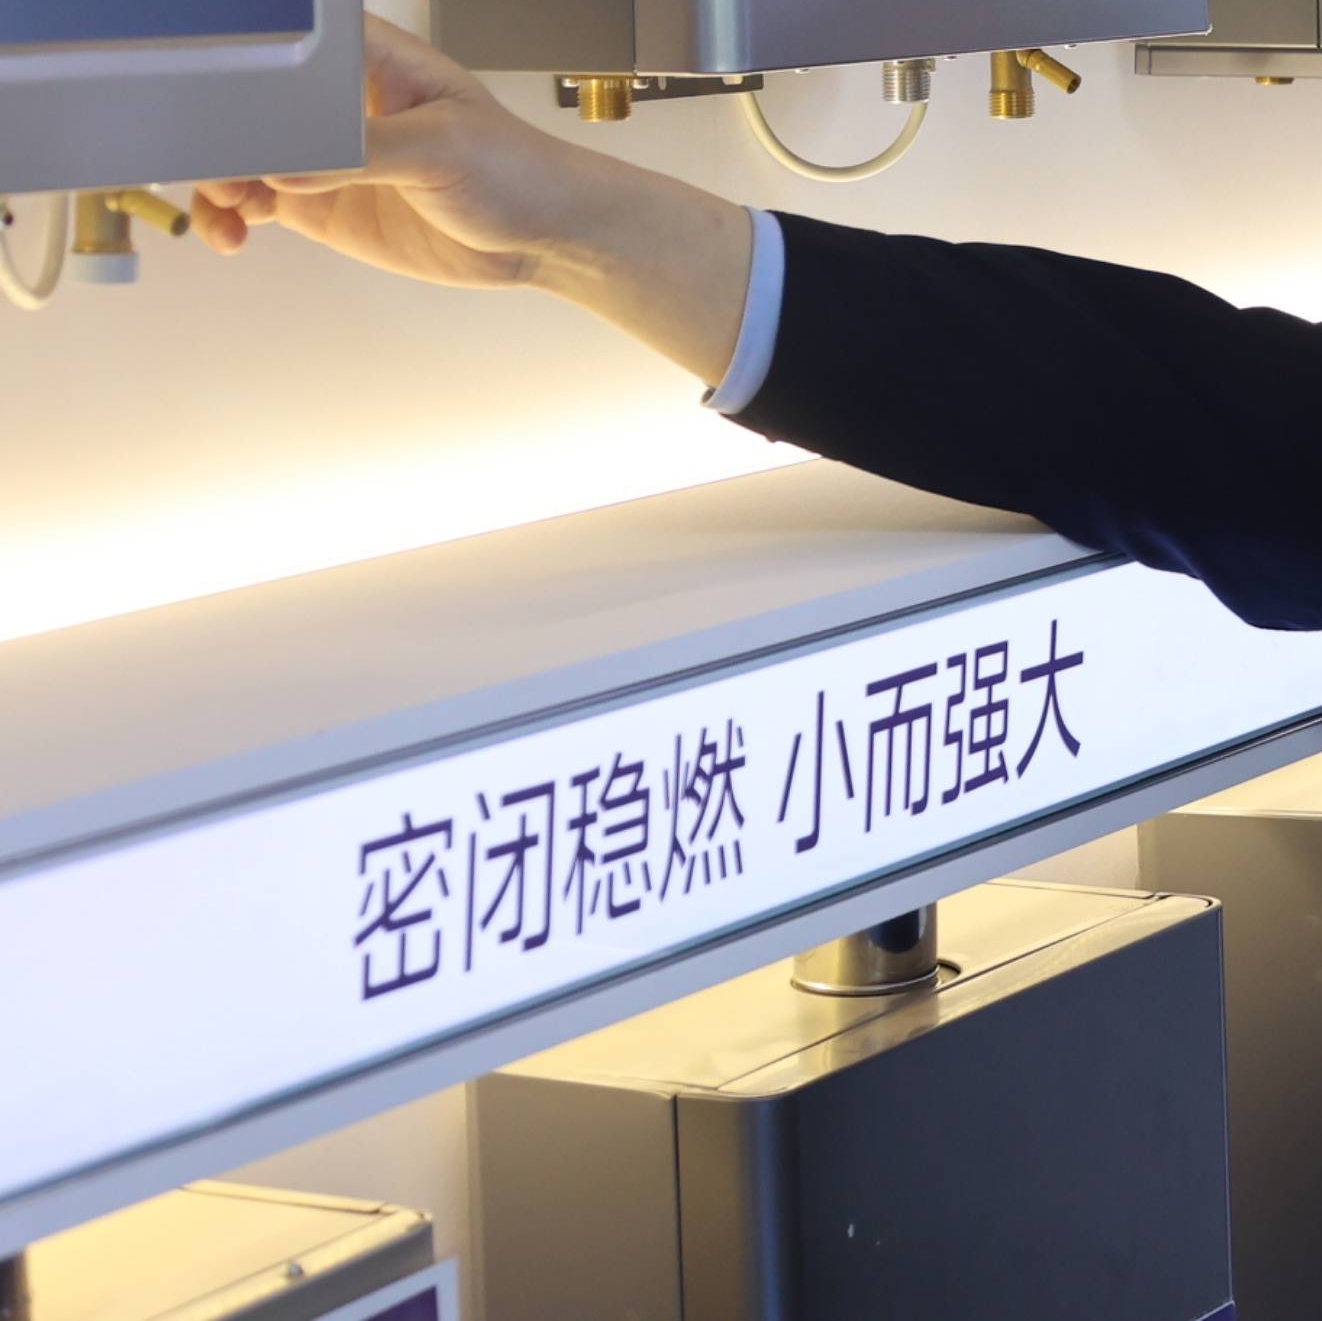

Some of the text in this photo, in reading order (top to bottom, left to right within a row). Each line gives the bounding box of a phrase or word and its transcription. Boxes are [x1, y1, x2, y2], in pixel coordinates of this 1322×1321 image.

[352, 618, 1085, 1002] 密闭稳燃 小而强大
